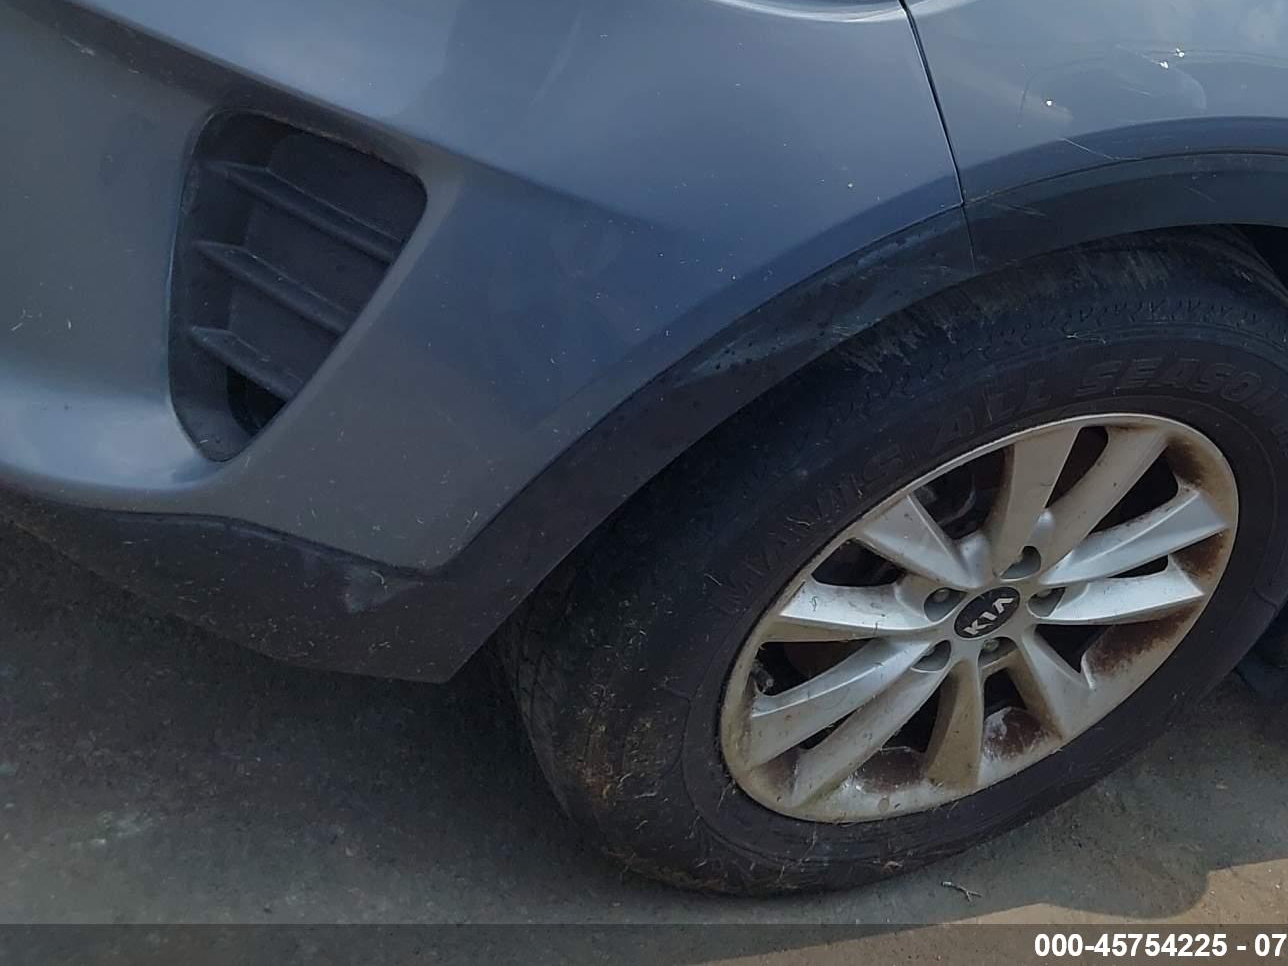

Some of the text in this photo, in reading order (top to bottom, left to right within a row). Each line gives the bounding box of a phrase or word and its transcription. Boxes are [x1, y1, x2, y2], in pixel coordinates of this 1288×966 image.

[932, 378, 1054, 452] ALL
[1071, 355, 1288, 418] SEASON
[963, 597, 1014, 636] KIA
